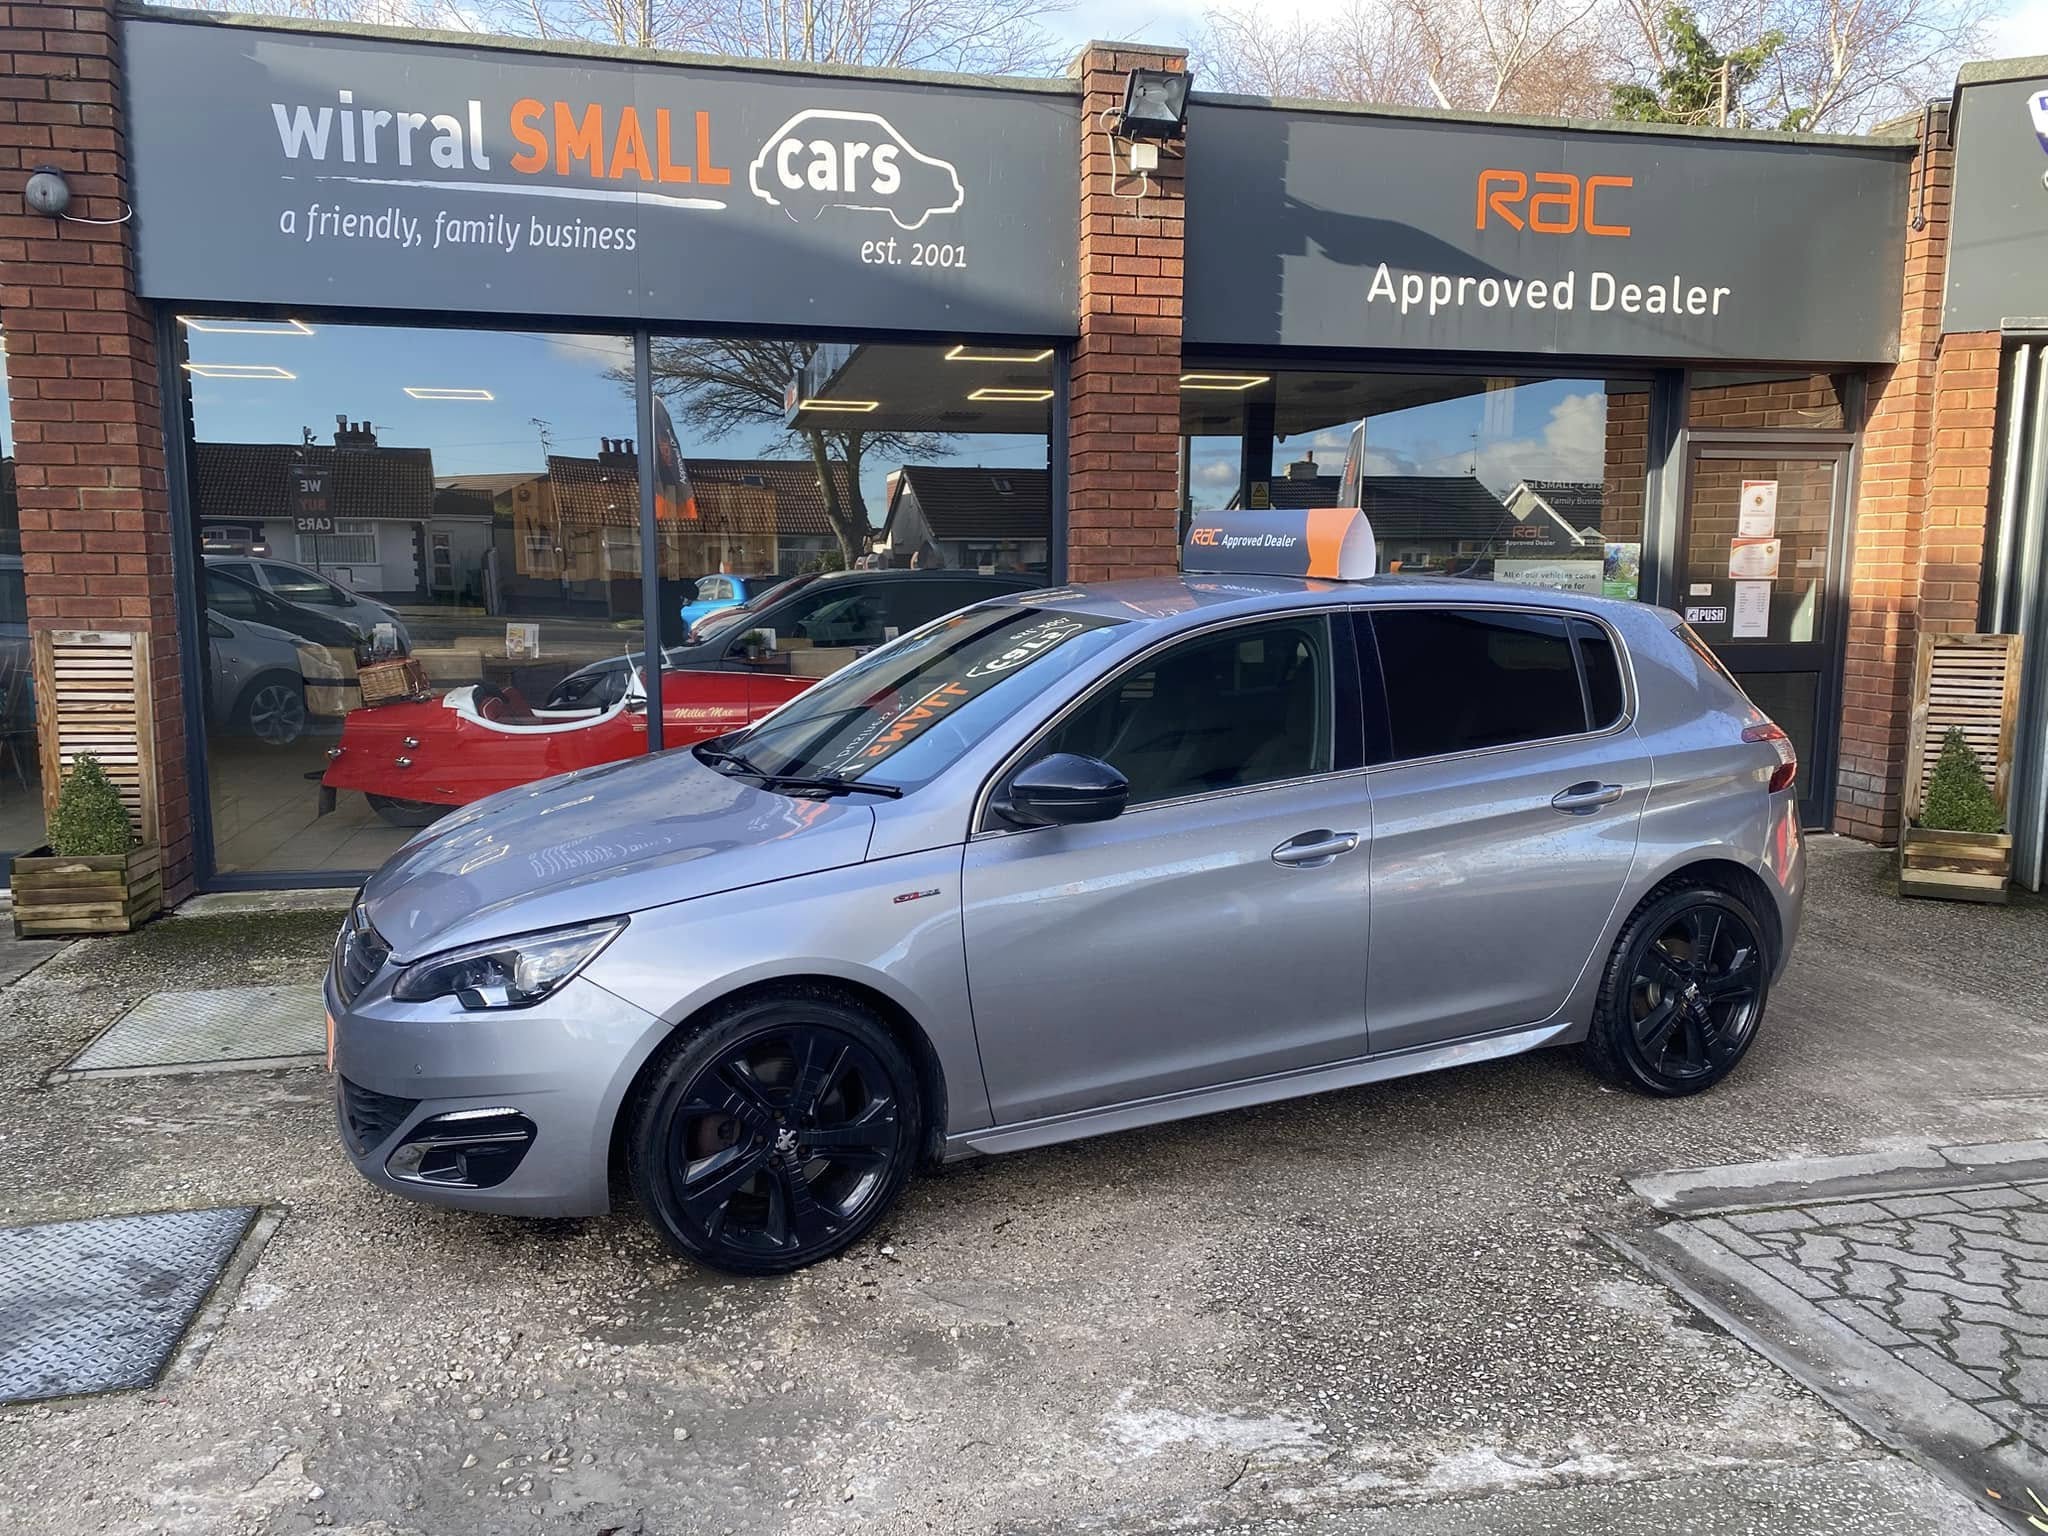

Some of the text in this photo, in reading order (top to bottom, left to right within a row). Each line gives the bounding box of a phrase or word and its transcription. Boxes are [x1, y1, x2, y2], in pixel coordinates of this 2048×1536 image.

[271, 89, 731, 186] wirral SMALL
[776, 139, 901, 194] cars
[279, 203, 637, 253] a friendly, family business
[860, 239, 968, 269] est. 2001
[1367, 262, 1732, 316] Approved Dealer
[1221, 533, 1264, 549] Approved
[1263, 534, 1297, 548] Dealer
[1574, 581, 1586, 590] for
[1699, 608, 1724, 621] PUSH
